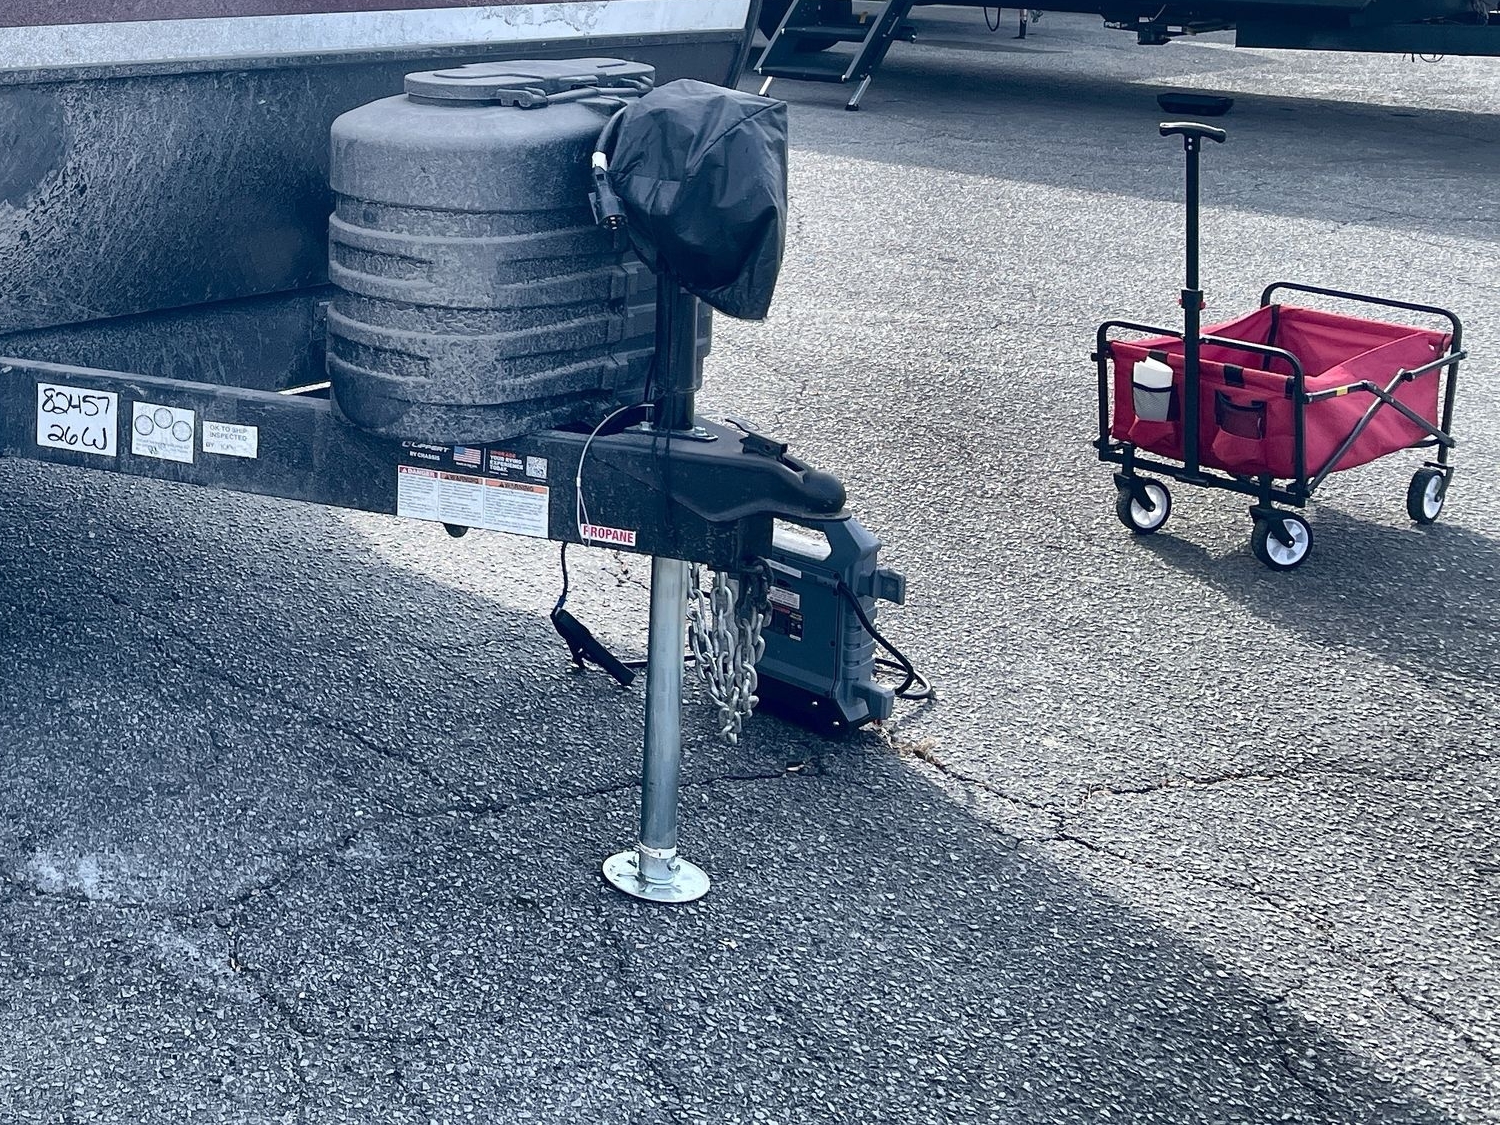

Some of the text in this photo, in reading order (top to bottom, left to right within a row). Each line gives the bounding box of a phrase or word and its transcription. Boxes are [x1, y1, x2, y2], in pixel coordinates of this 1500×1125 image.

[41, 388, 110, 417] 82457
[209, 432, 248, 442] INSPECTED
[408, 468, 436, 477] DANGER
[583, 525, 634, 543] PROPANE
